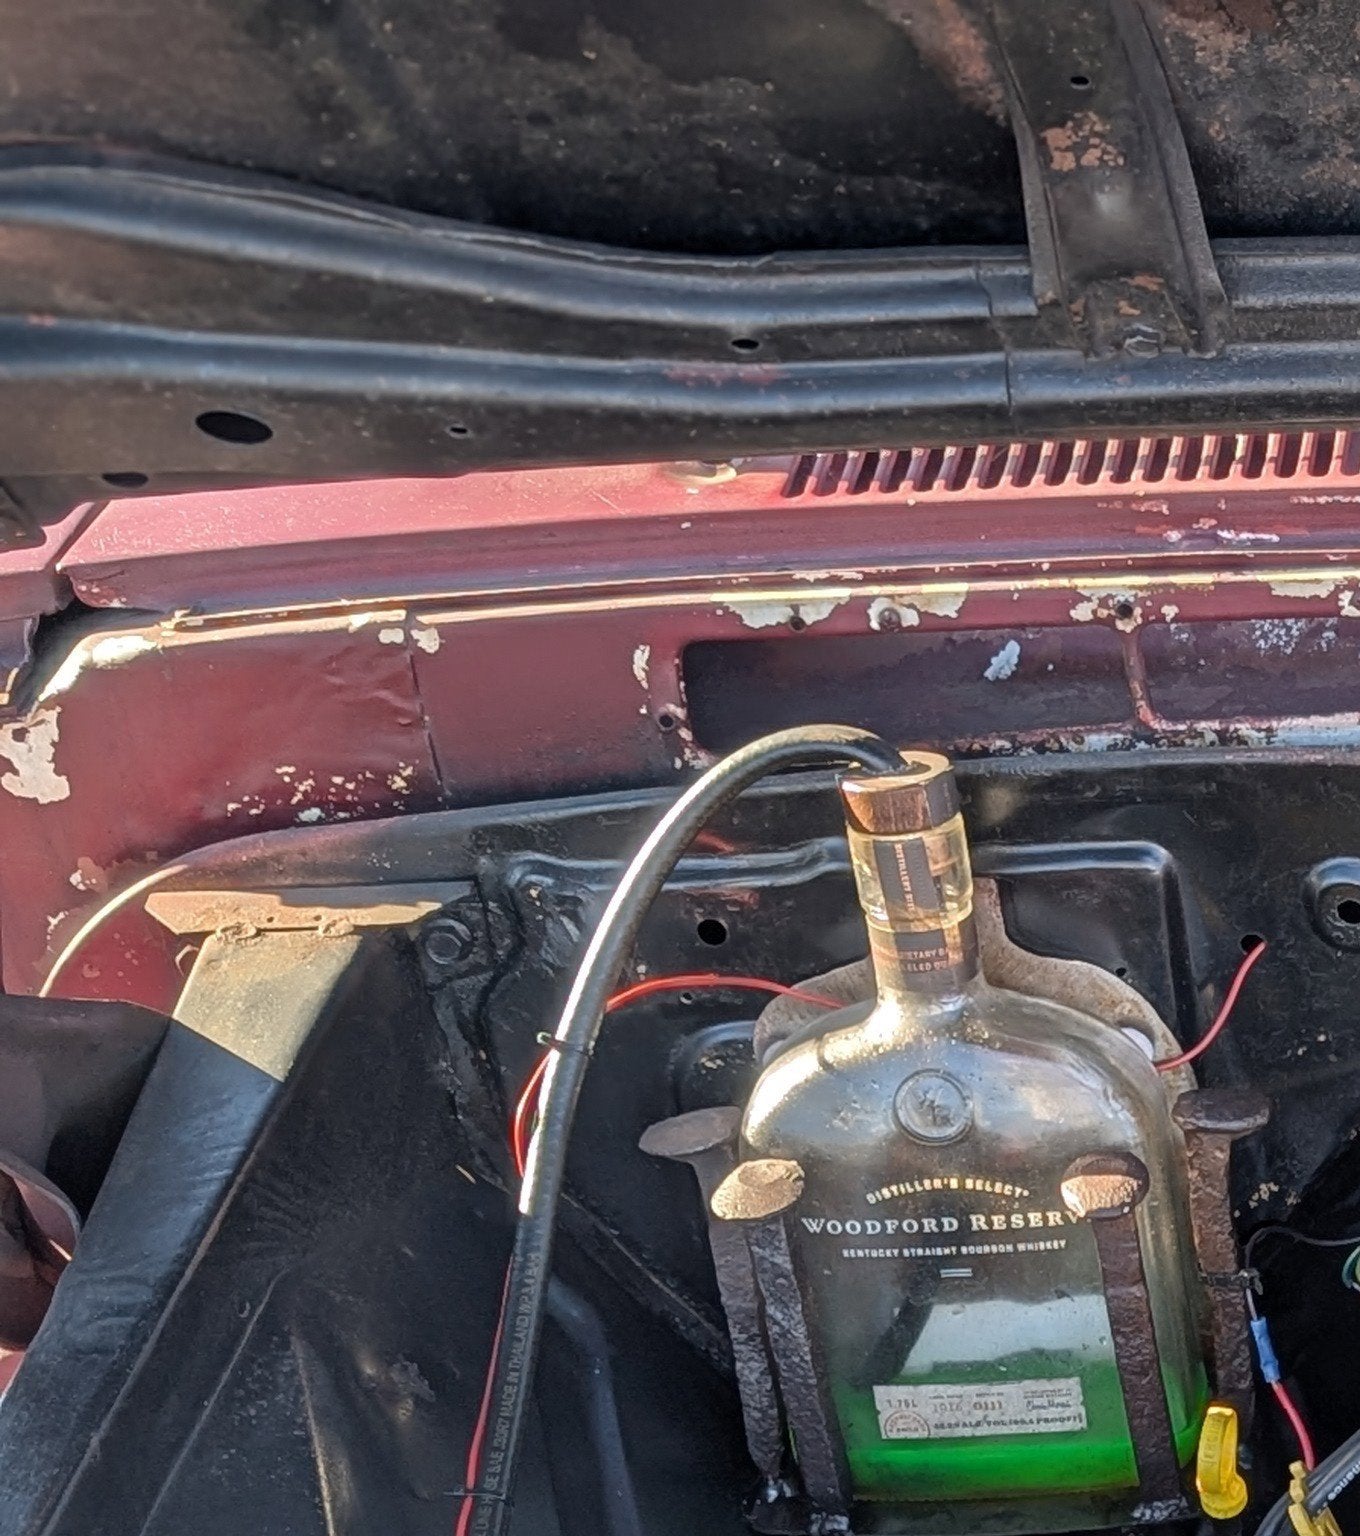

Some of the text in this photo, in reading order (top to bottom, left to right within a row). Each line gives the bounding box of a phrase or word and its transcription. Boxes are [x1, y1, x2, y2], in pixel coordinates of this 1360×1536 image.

[866, 1176, 959, 1205] DISTILLER'S
[801, 1209, 1082, 1236] WOODFORD RESERV
[842, 1247, 899, 1259] KENTUCKY
[511, 1314, 529, 1369] THAILAND
[507, 1369, 519, 1384] IN
[500, 1385, 517, 1416] MADE
